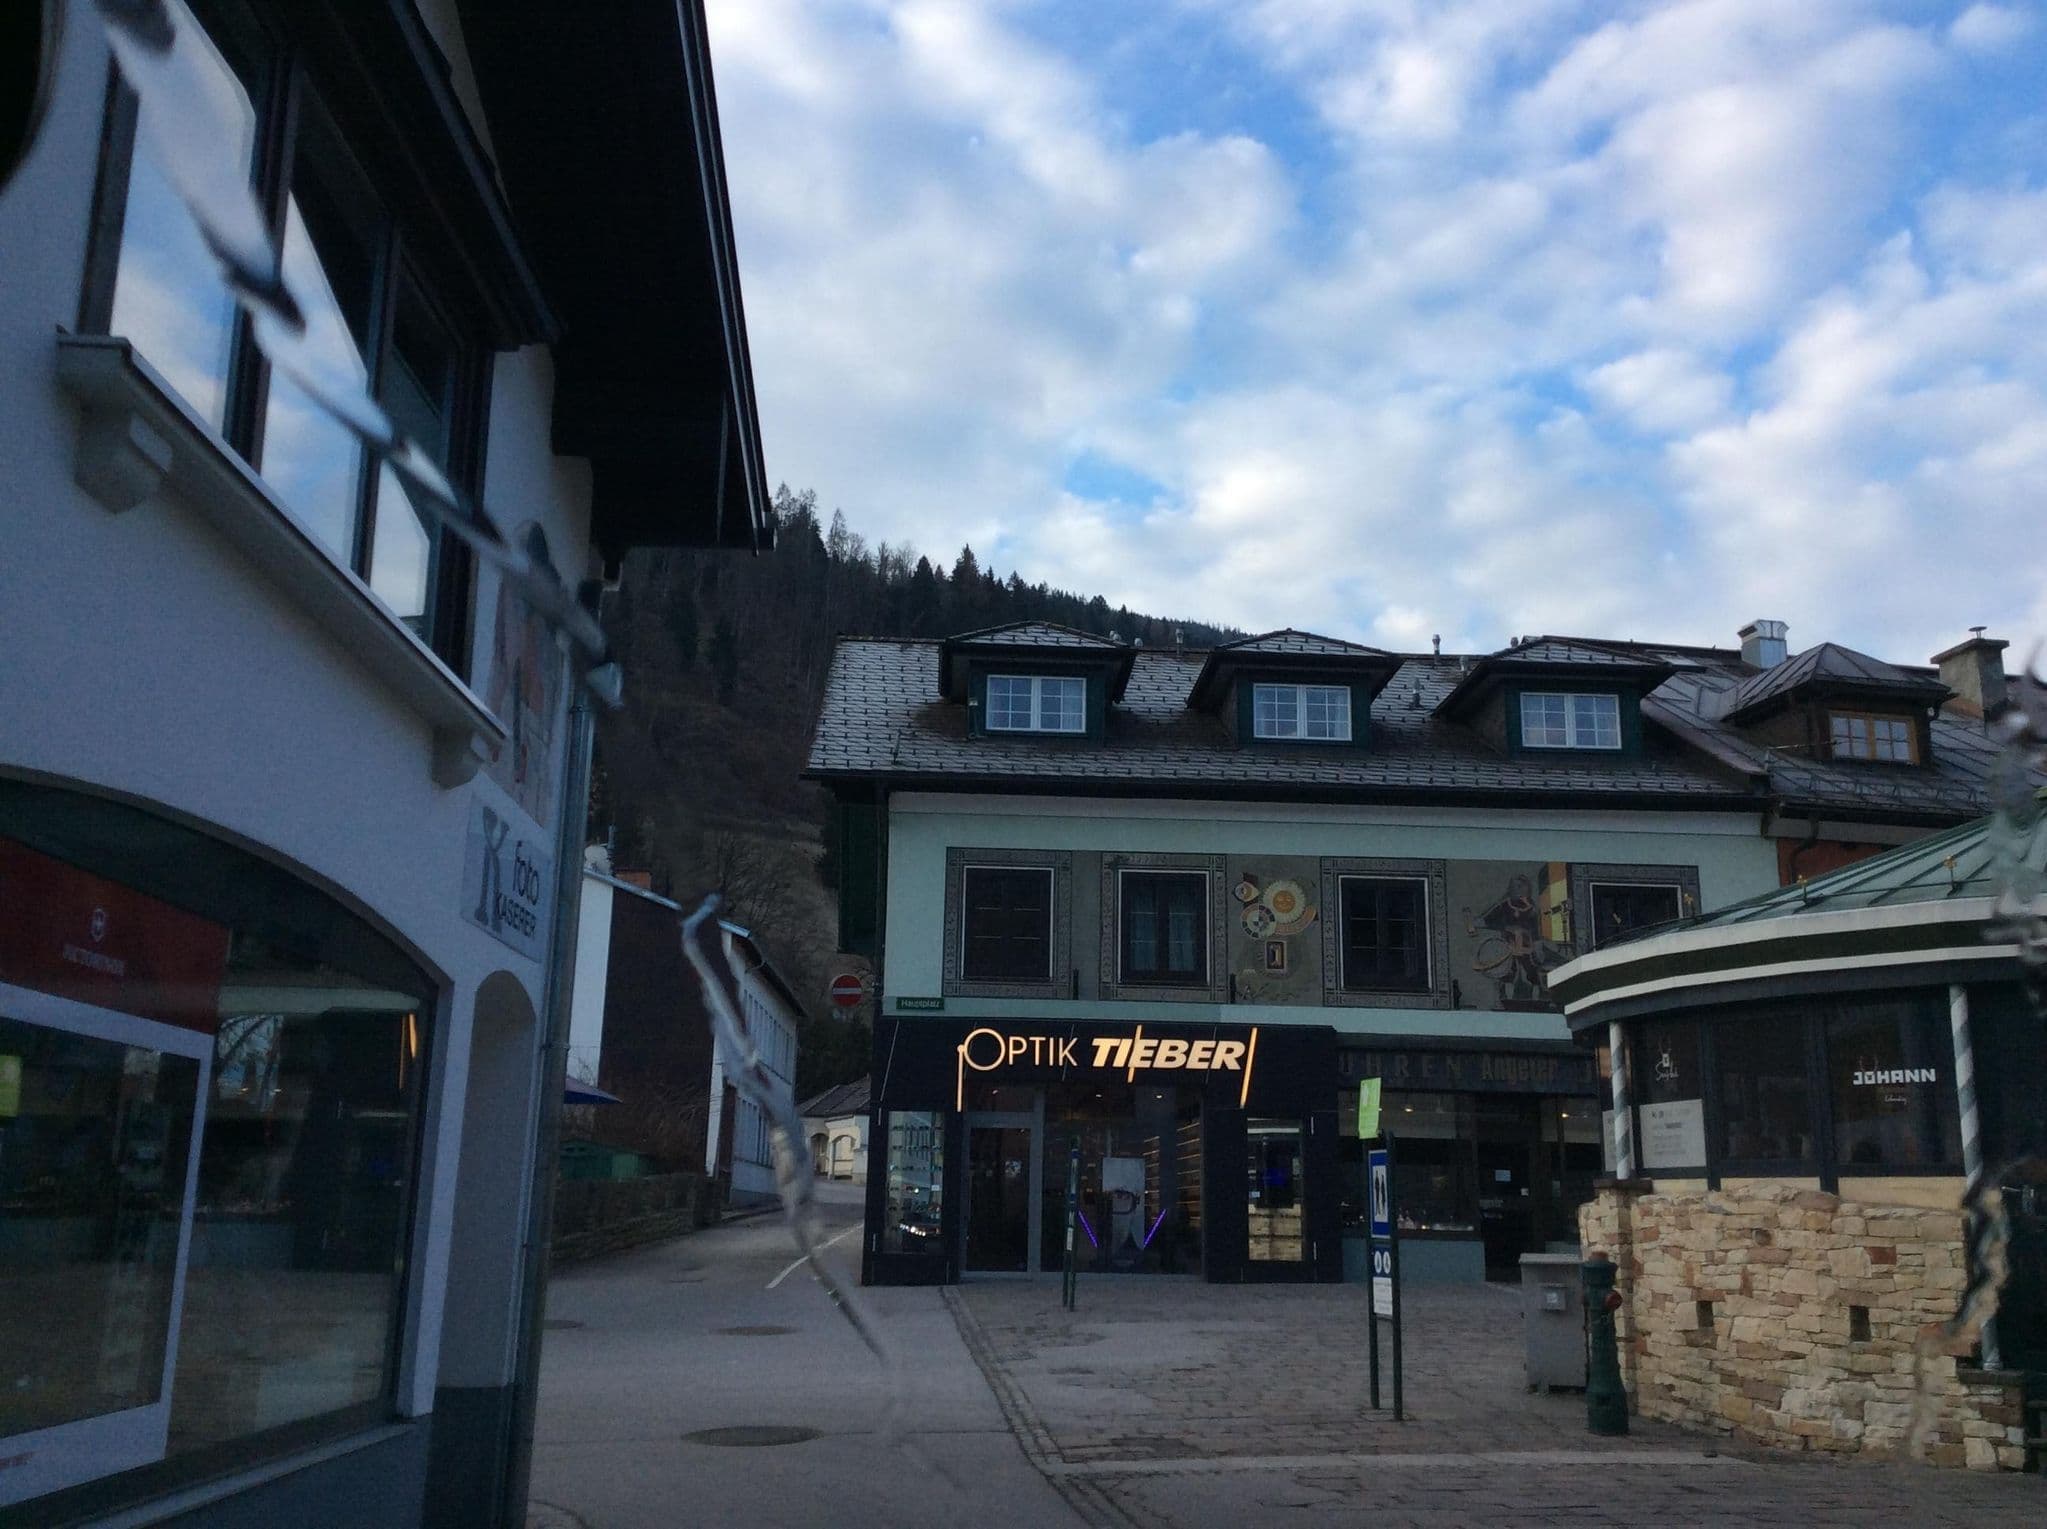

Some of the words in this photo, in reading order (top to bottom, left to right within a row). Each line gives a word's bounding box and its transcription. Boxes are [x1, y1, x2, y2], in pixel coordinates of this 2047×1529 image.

[495, 890, 537, 937] KASERER
[1339, 1053, 1462, 1079] UHREN
[1852, 1067, 1936, 1086] JOHANN
